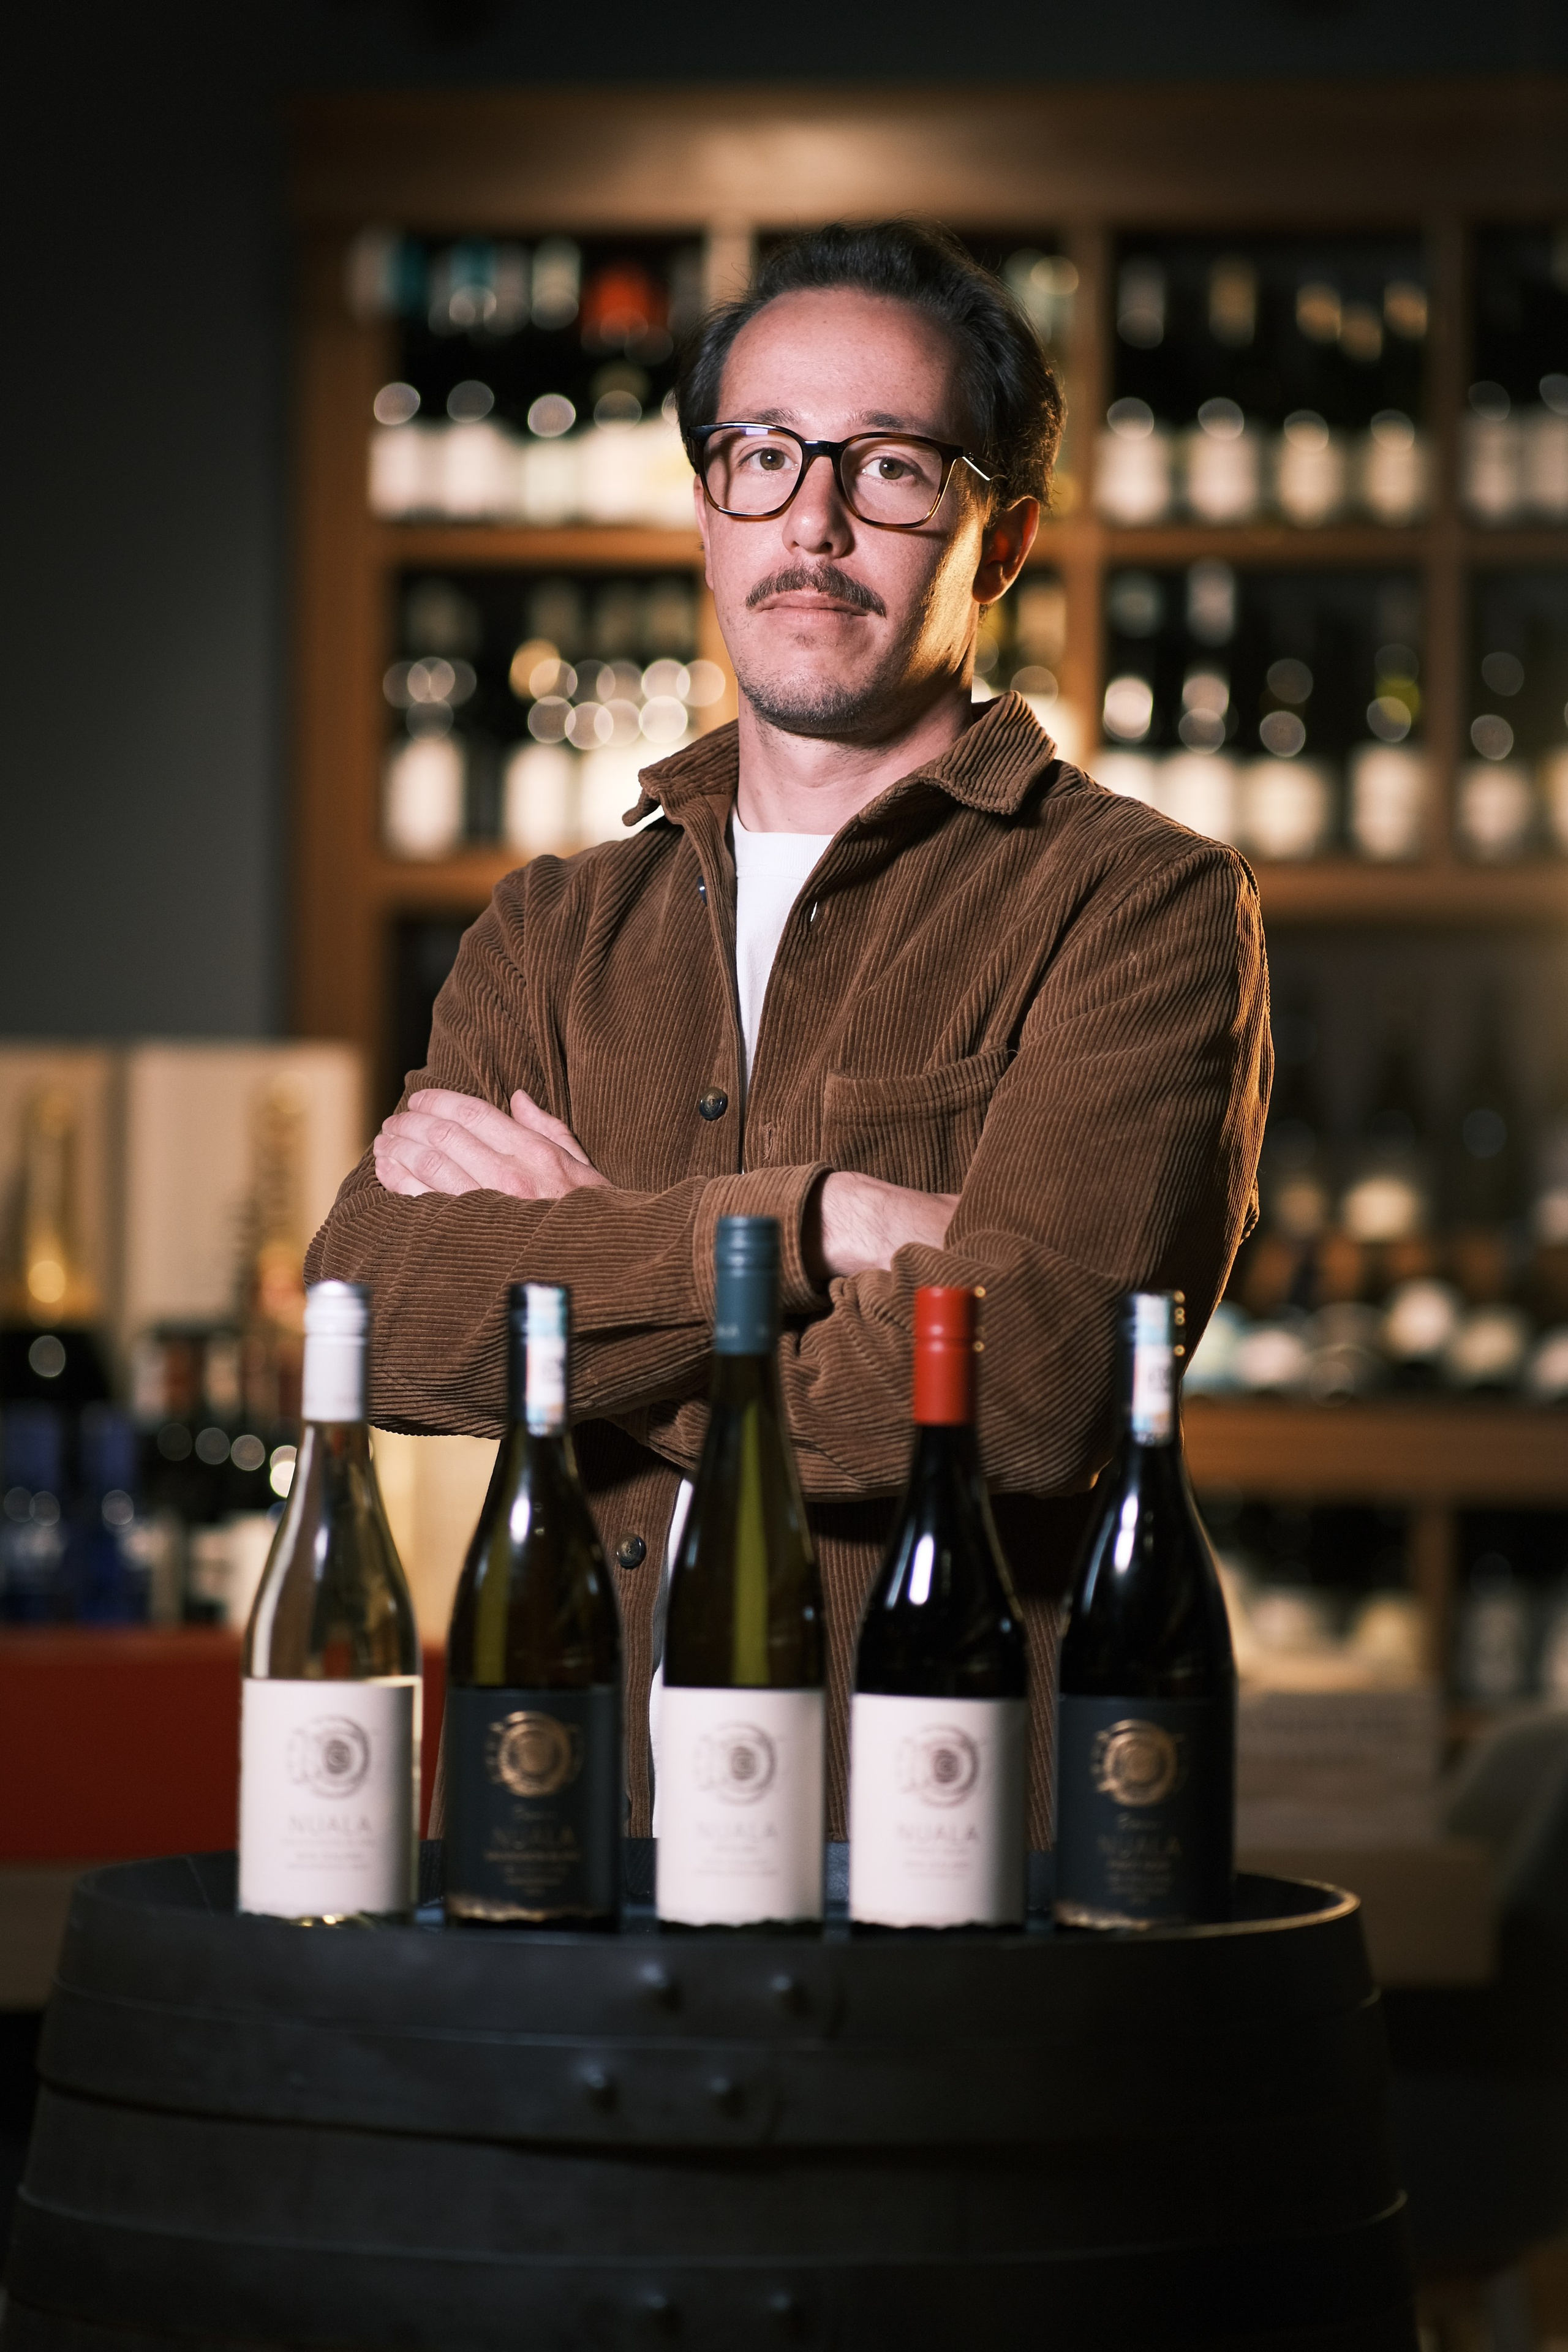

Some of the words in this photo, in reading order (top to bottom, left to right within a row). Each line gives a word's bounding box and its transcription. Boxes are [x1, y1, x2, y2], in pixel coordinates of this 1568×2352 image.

[288, 1814, 373, 1836] NUALA
[695, 1820, 778, 1843] NUALA
[894, 1821, 980, 1845] NUALA
